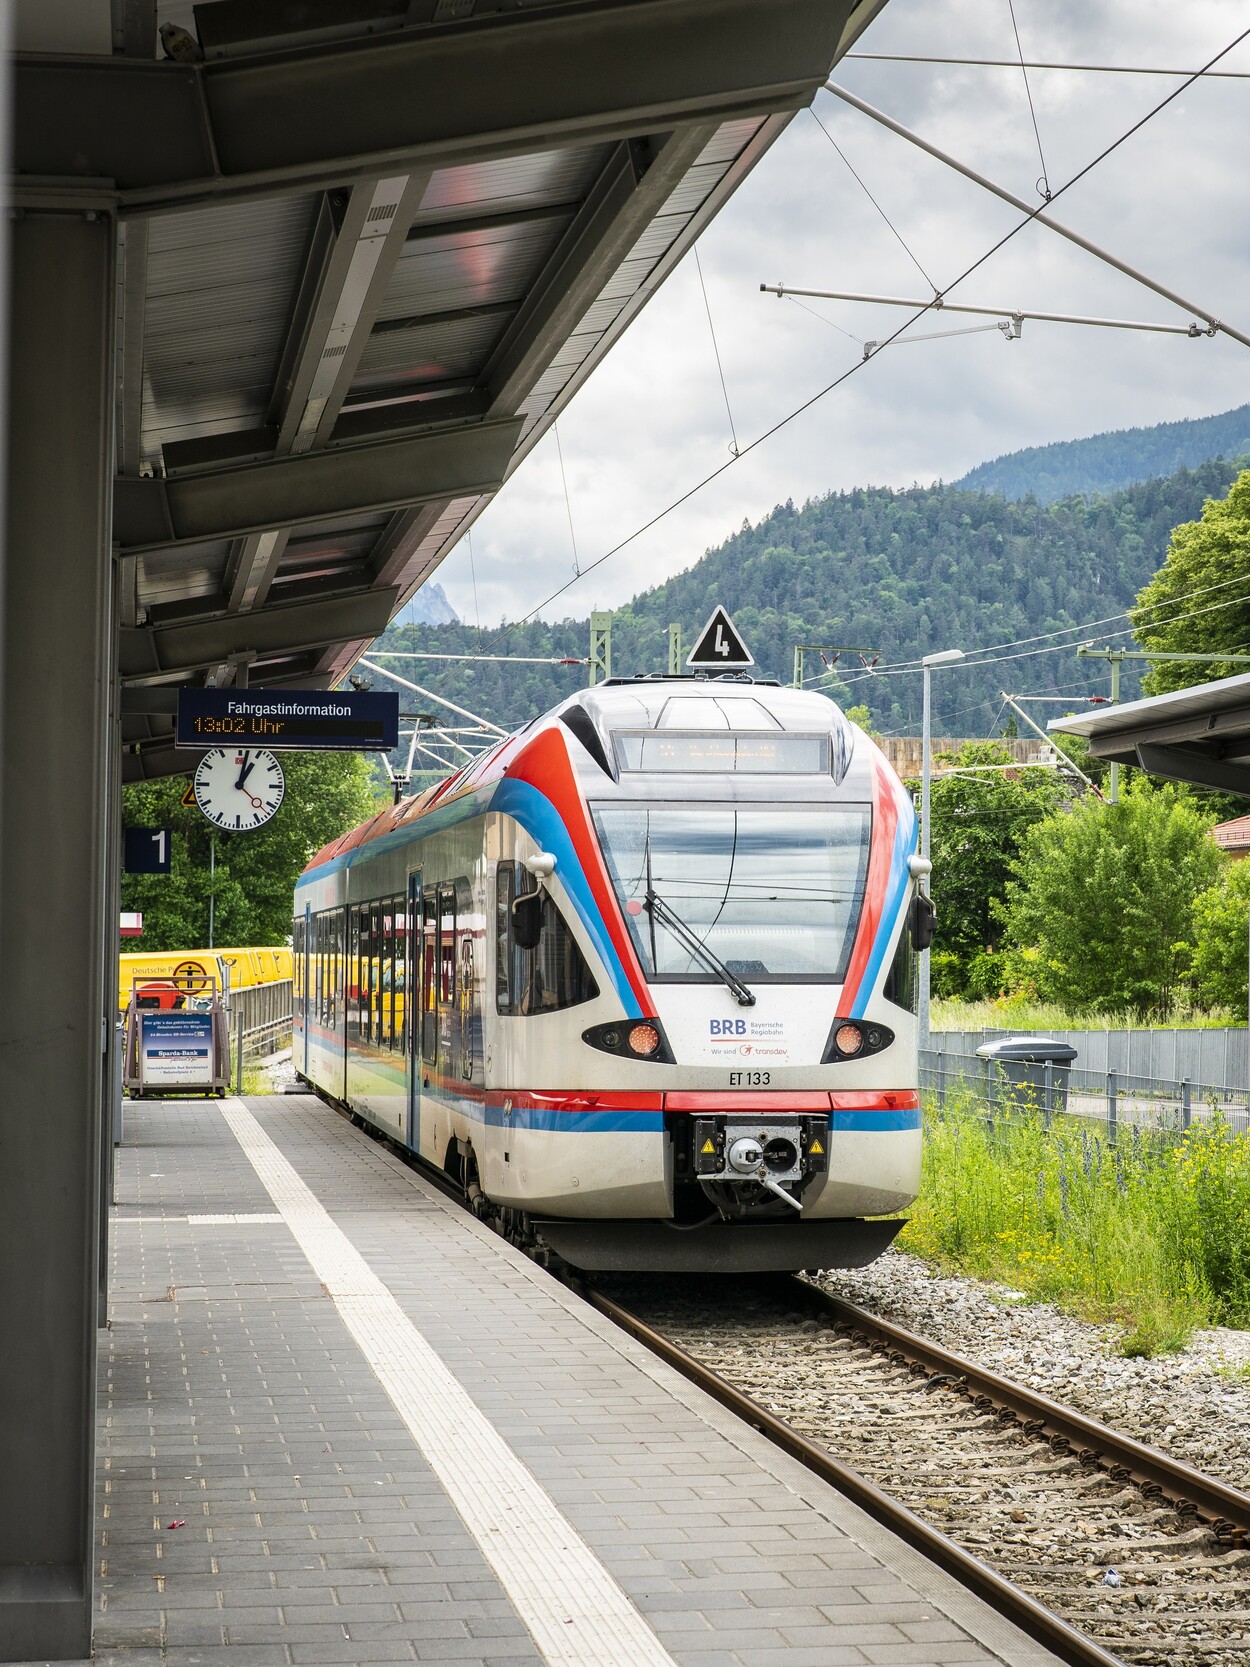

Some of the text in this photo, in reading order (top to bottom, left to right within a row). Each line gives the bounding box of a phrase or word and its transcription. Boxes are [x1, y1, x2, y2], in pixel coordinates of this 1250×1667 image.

[715, 625, 730, 657] 4
[227, 701, 351, 717] Fahrgastinformation
[194, 717, 285, 734] 13:02 Uhr
[151, 830, 166, 864] 1
[132, 966, 167, 975] Deutsche
[710, 1019, 747, 1035] BRB
[729, 1071, 771, 1086] ET 133
